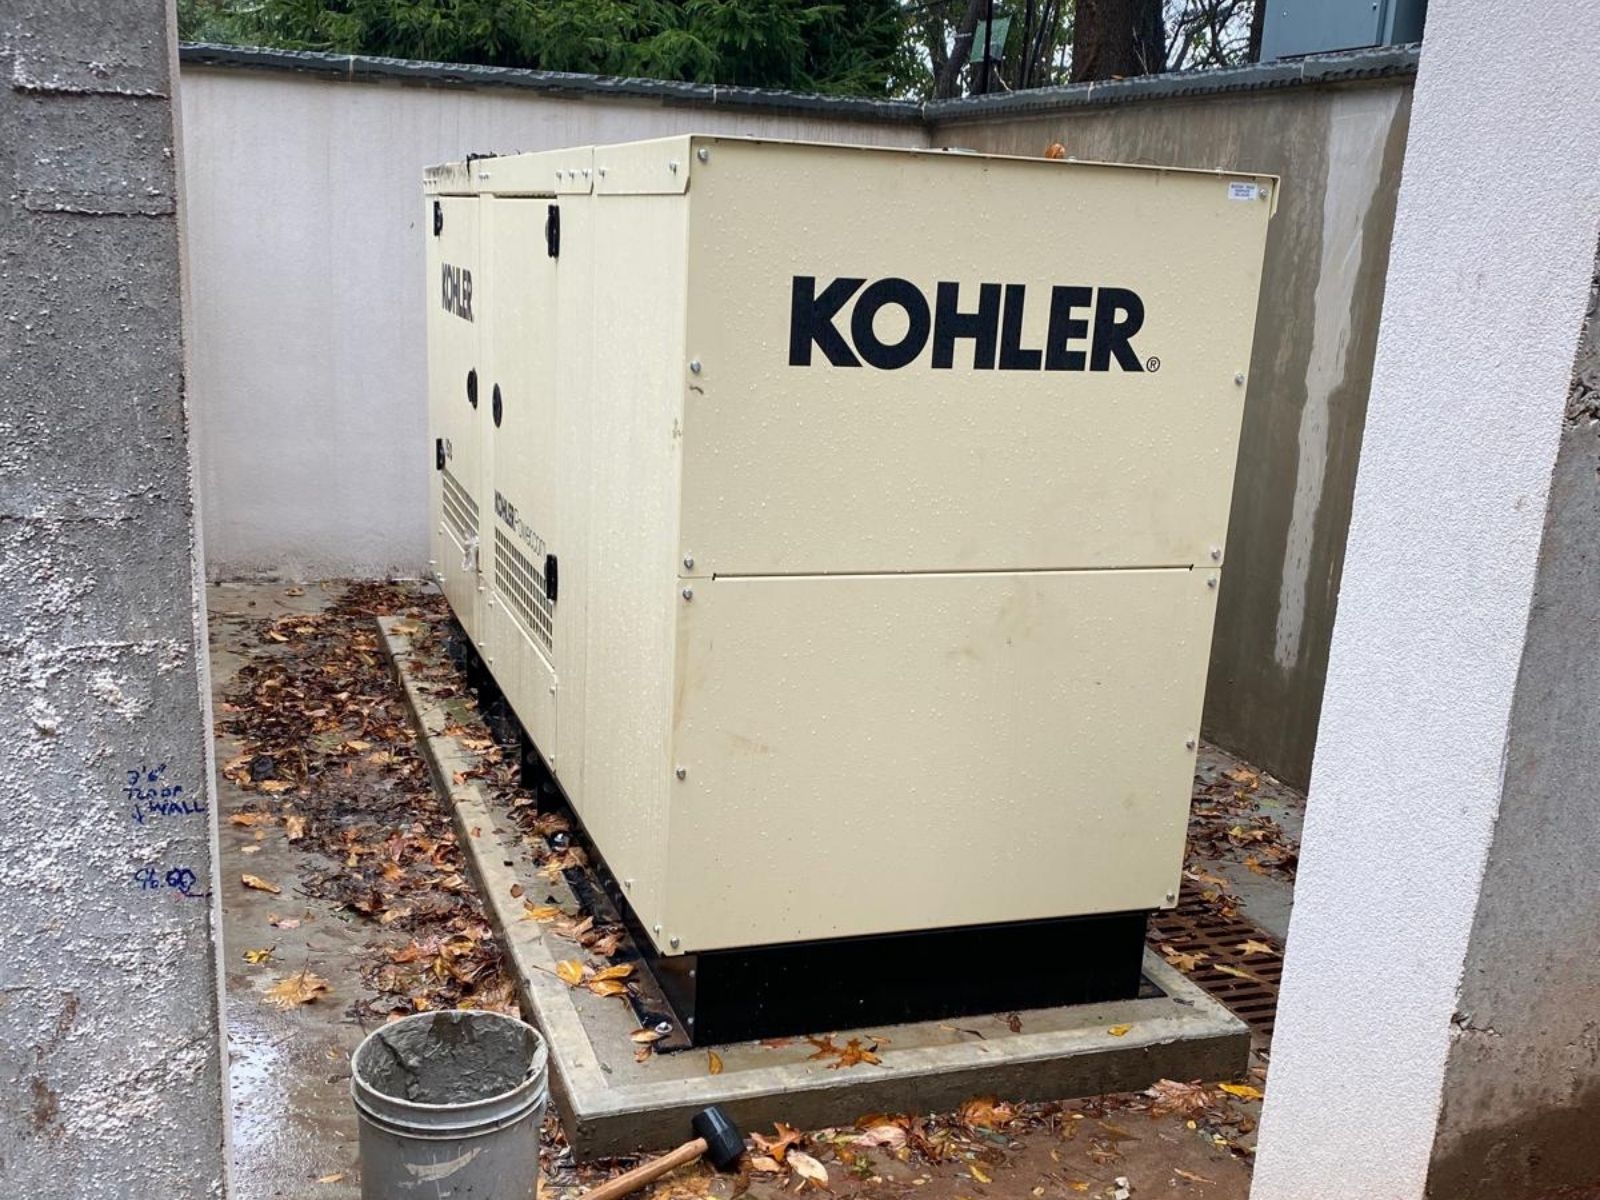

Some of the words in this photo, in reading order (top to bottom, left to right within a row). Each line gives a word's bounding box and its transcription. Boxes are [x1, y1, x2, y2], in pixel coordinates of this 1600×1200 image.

[442, 263, 474, 322] KOHLER
[789, 275, 1145, 372] KOHLER
[148, 801, 205, 815] WALL
